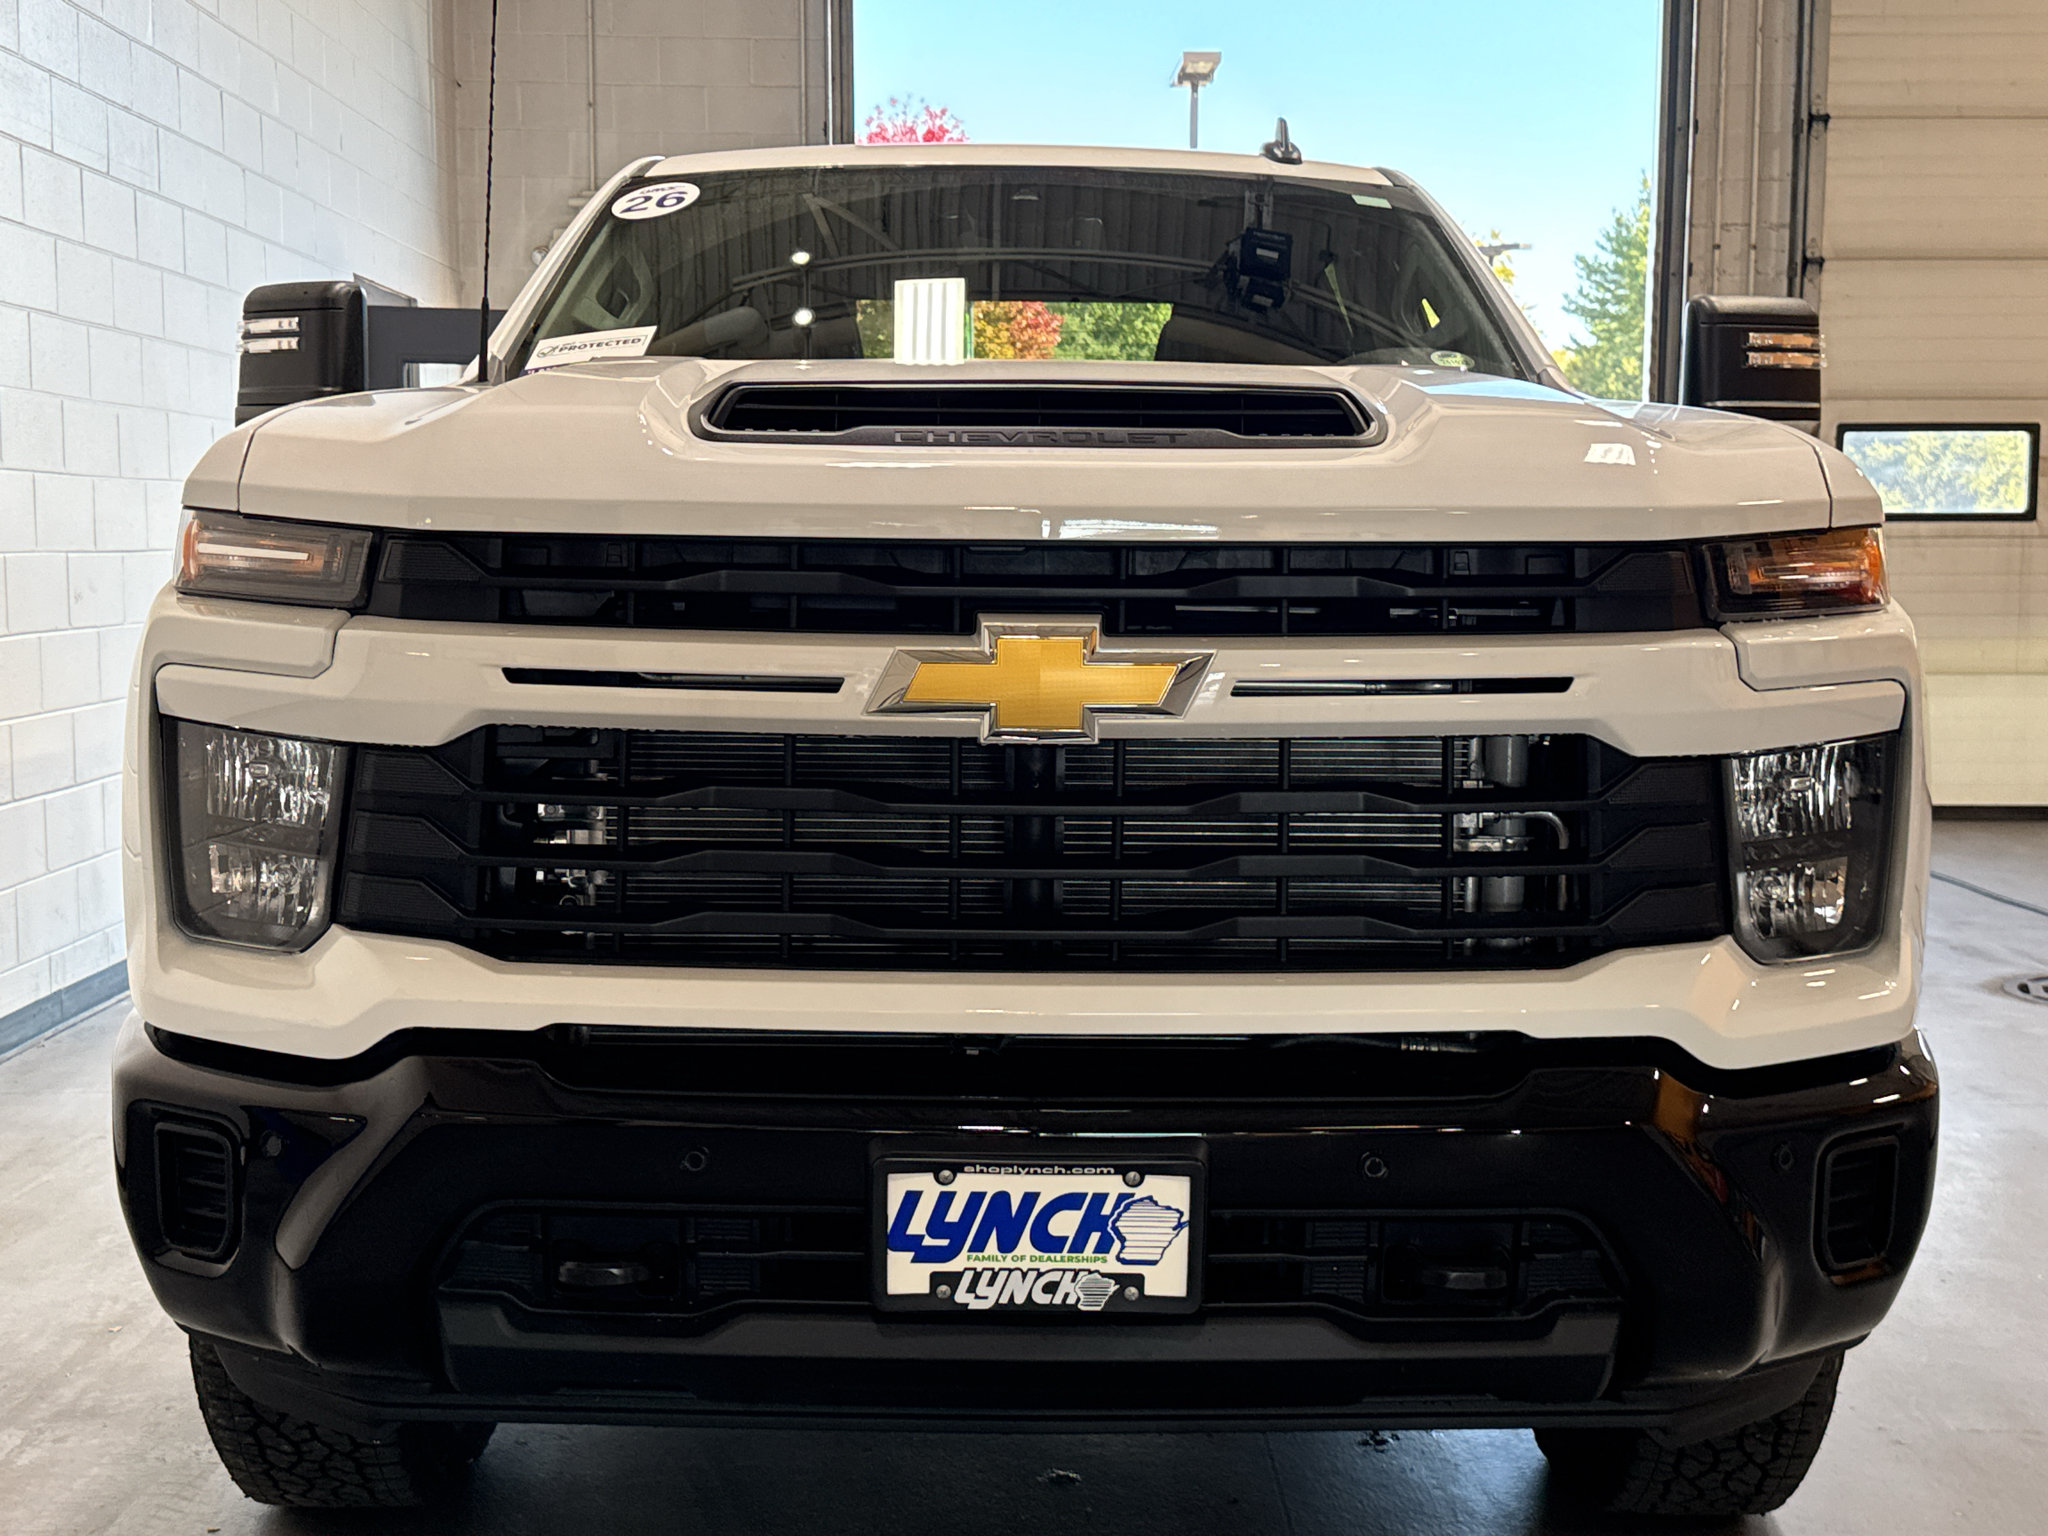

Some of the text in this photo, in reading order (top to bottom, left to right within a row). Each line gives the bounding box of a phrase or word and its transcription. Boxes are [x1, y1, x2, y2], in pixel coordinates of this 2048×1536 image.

[619, 191, 688, 214] 26
[558, 338, 642, 352] PROTECTED
[894, 430, 1188, 444] CHEVROLET
[963, 1164, 1115, 1175] shoplynch.com
[887, 1190, 1136, 1264] LYNCH
[966, 1254, 1108, 1264] FAMILY OF DEALERSHIPS
[954, 1269, 1087, 1310] LYNCH
